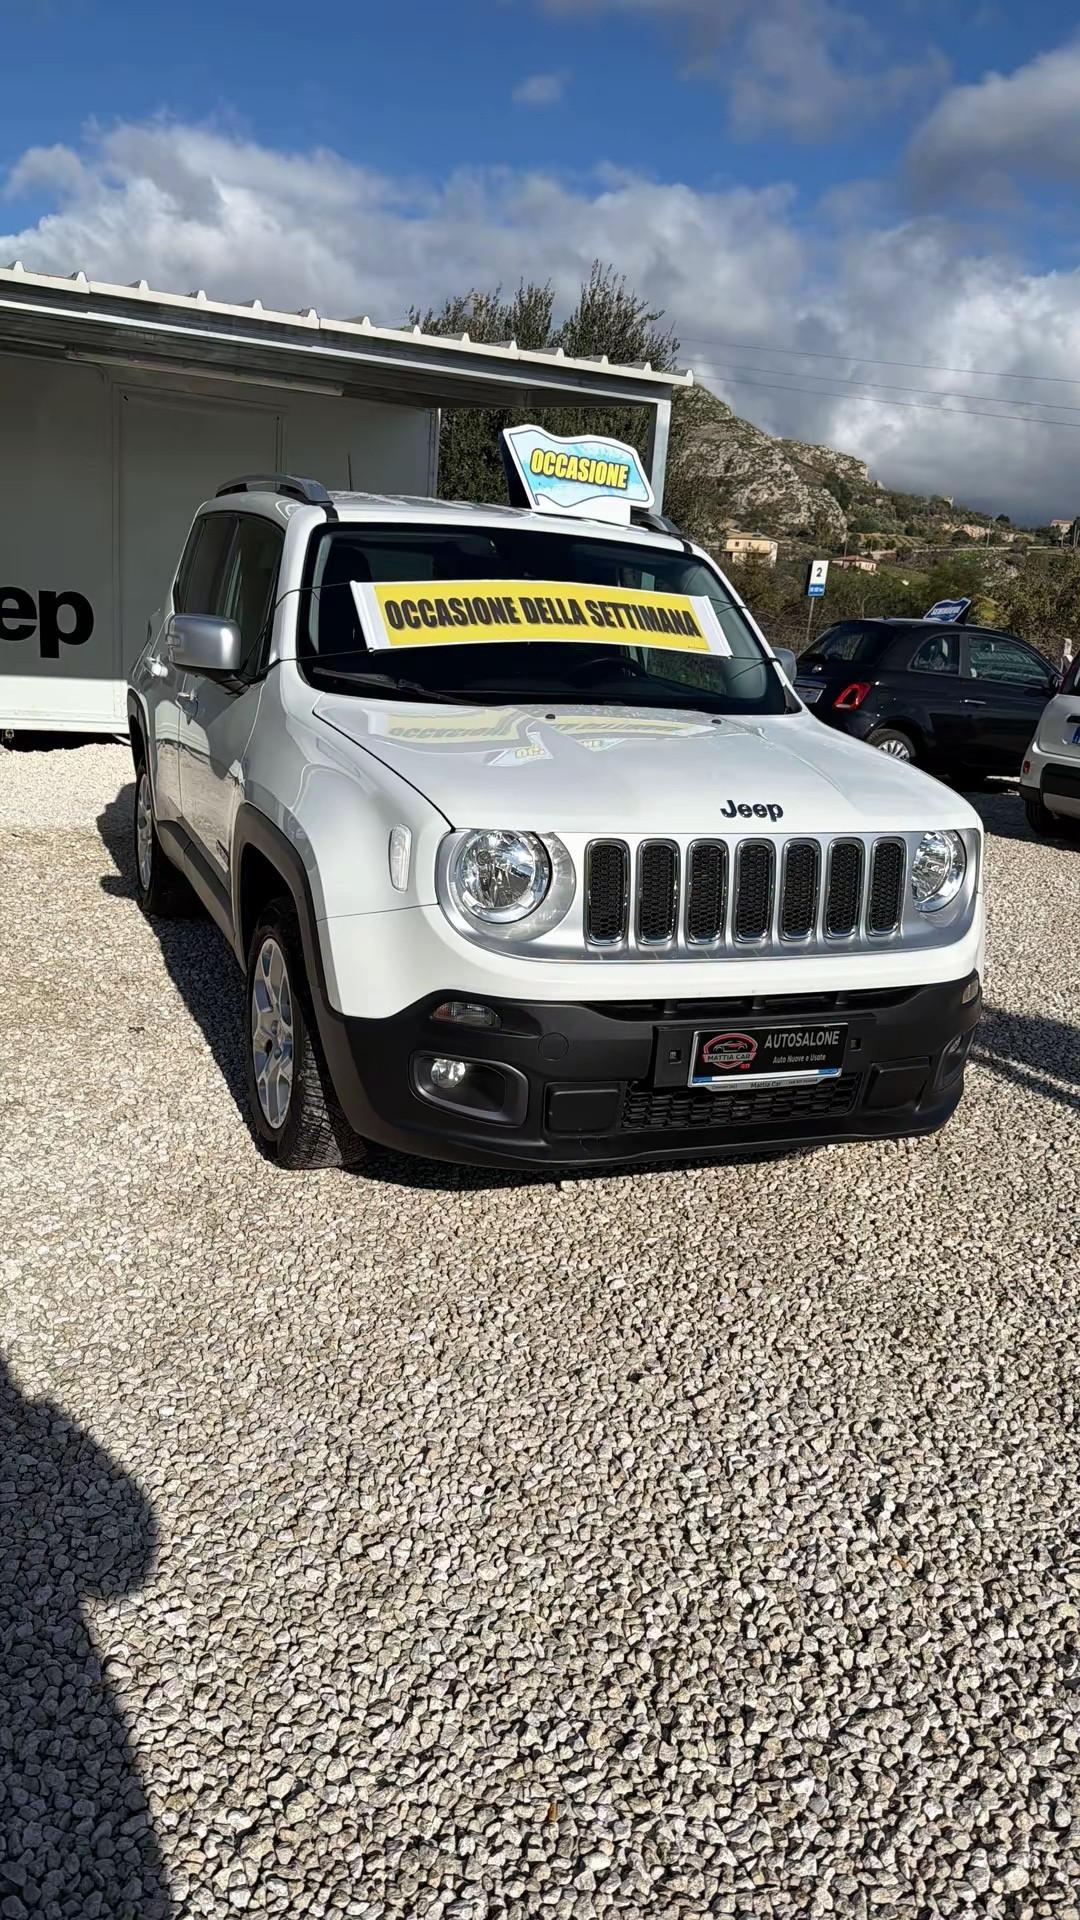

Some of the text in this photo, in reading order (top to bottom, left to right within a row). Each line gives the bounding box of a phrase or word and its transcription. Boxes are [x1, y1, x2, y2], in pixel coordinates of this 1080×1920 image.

[531, 448, 629, 490] OCCASIONE
[816, 567, 823, 577] 2
[0, 587, 94, 659] ep
[385, 597, 703, 638] OCCASIONE DELLA SETTIMANA
[720, 800, 784, 822] Jeep
[764, 1031, 840, 1048] AUTOSALONE
